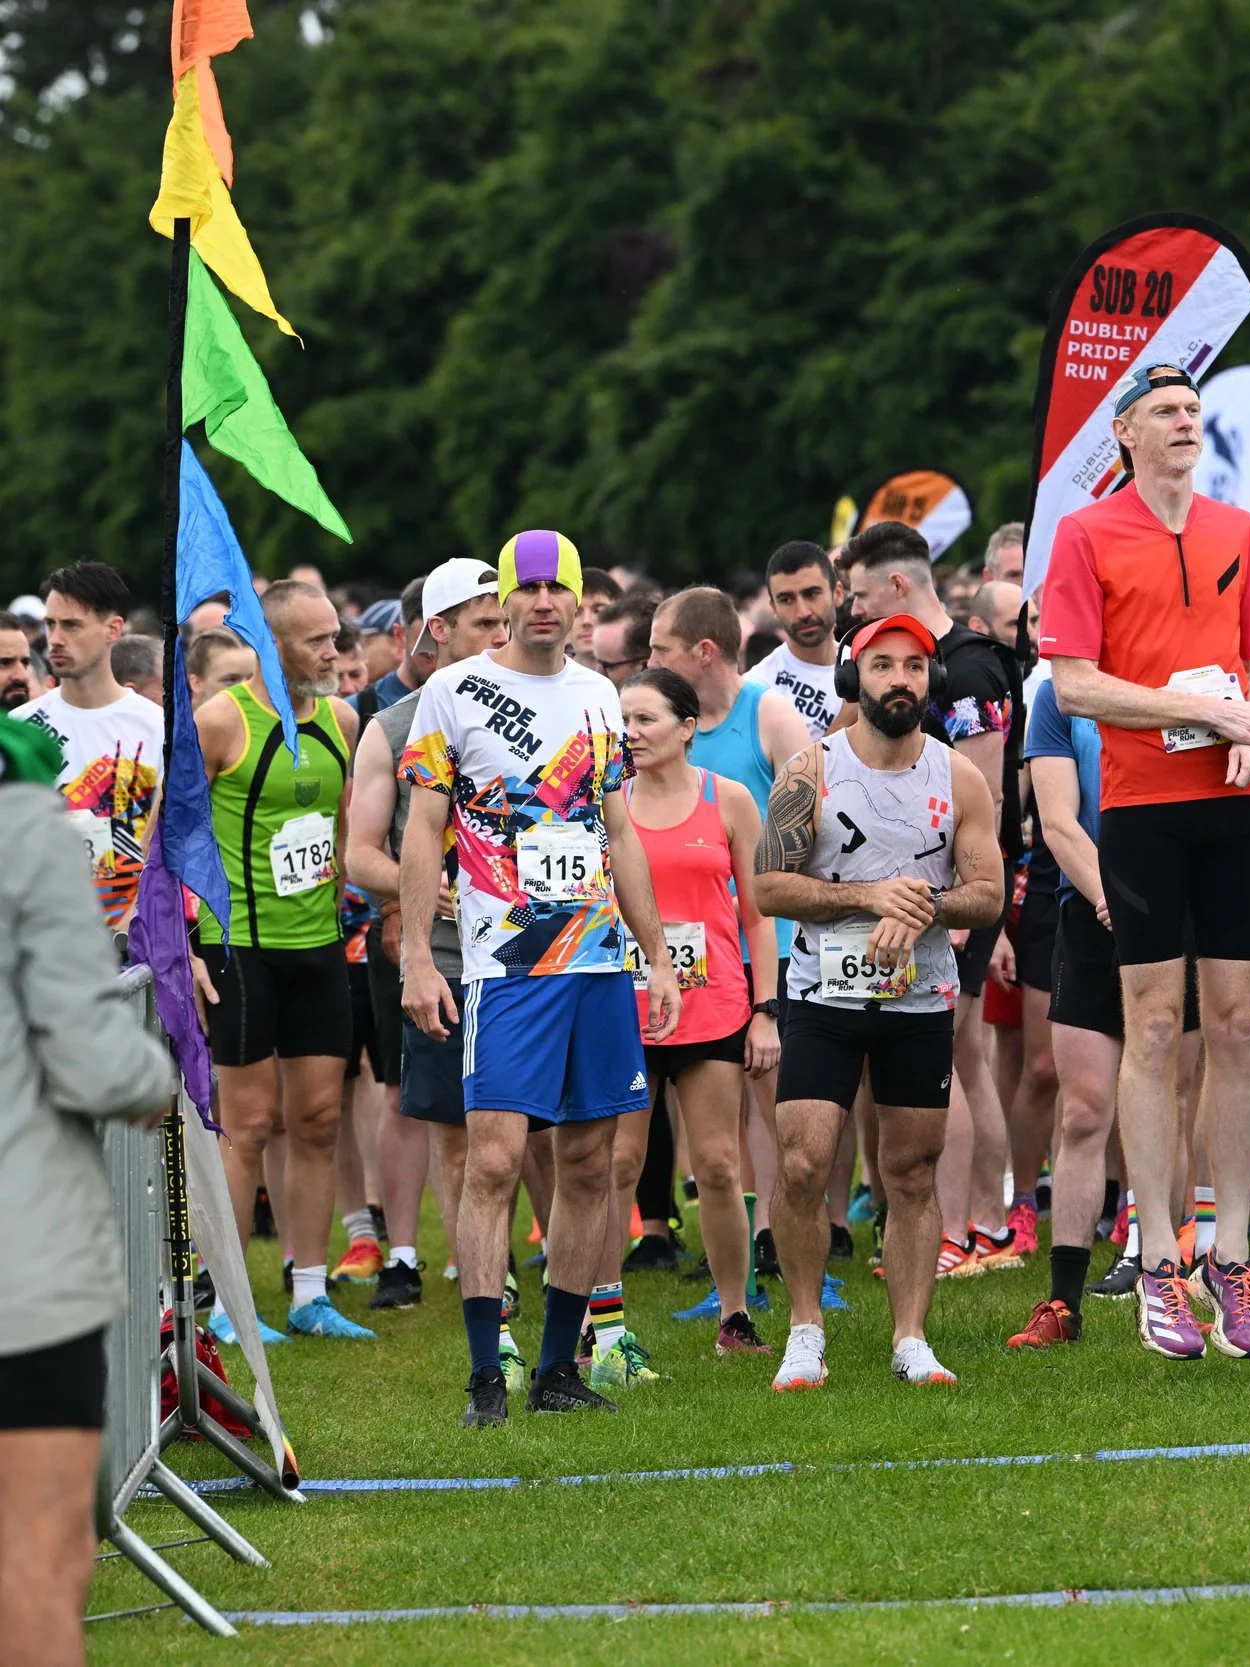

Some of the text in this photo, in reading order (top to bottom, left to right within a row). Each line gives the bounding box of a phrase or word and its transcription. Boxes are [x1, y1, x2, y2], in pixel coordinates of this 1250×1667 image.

[1090, 264, 1173, 318] SUB 20
[1069, 319, 1148, 341] DUBLIN
[1067, 341, 1131, 361] PRIDE
[1065, 362, 1107, 381] RUN
[1072, 435, 1112, 485] DUBLIN
[1081, 442, 1119, 491] FRONT
[467, 674, 501, 691] DUBLIN
[455, 678, 537, 728] PRIDE
[795, 697, 835, 727] RUN
[485, 711, 543, 755] RUN
[1168, 728, 1190, 738] PRIDE
[1179, 733, 1196, 742] RUN
[508, 746, 531, 762] 2024
[550, 729, 590, 783] PRIDE
[77, 753, 115, 797] PRIDE
[461, 810, 508, 848] 2024
[283, 839, 332, 873] 1782
[540, 855, 586, 880] 115
[629, 944, 696, 970] 123
